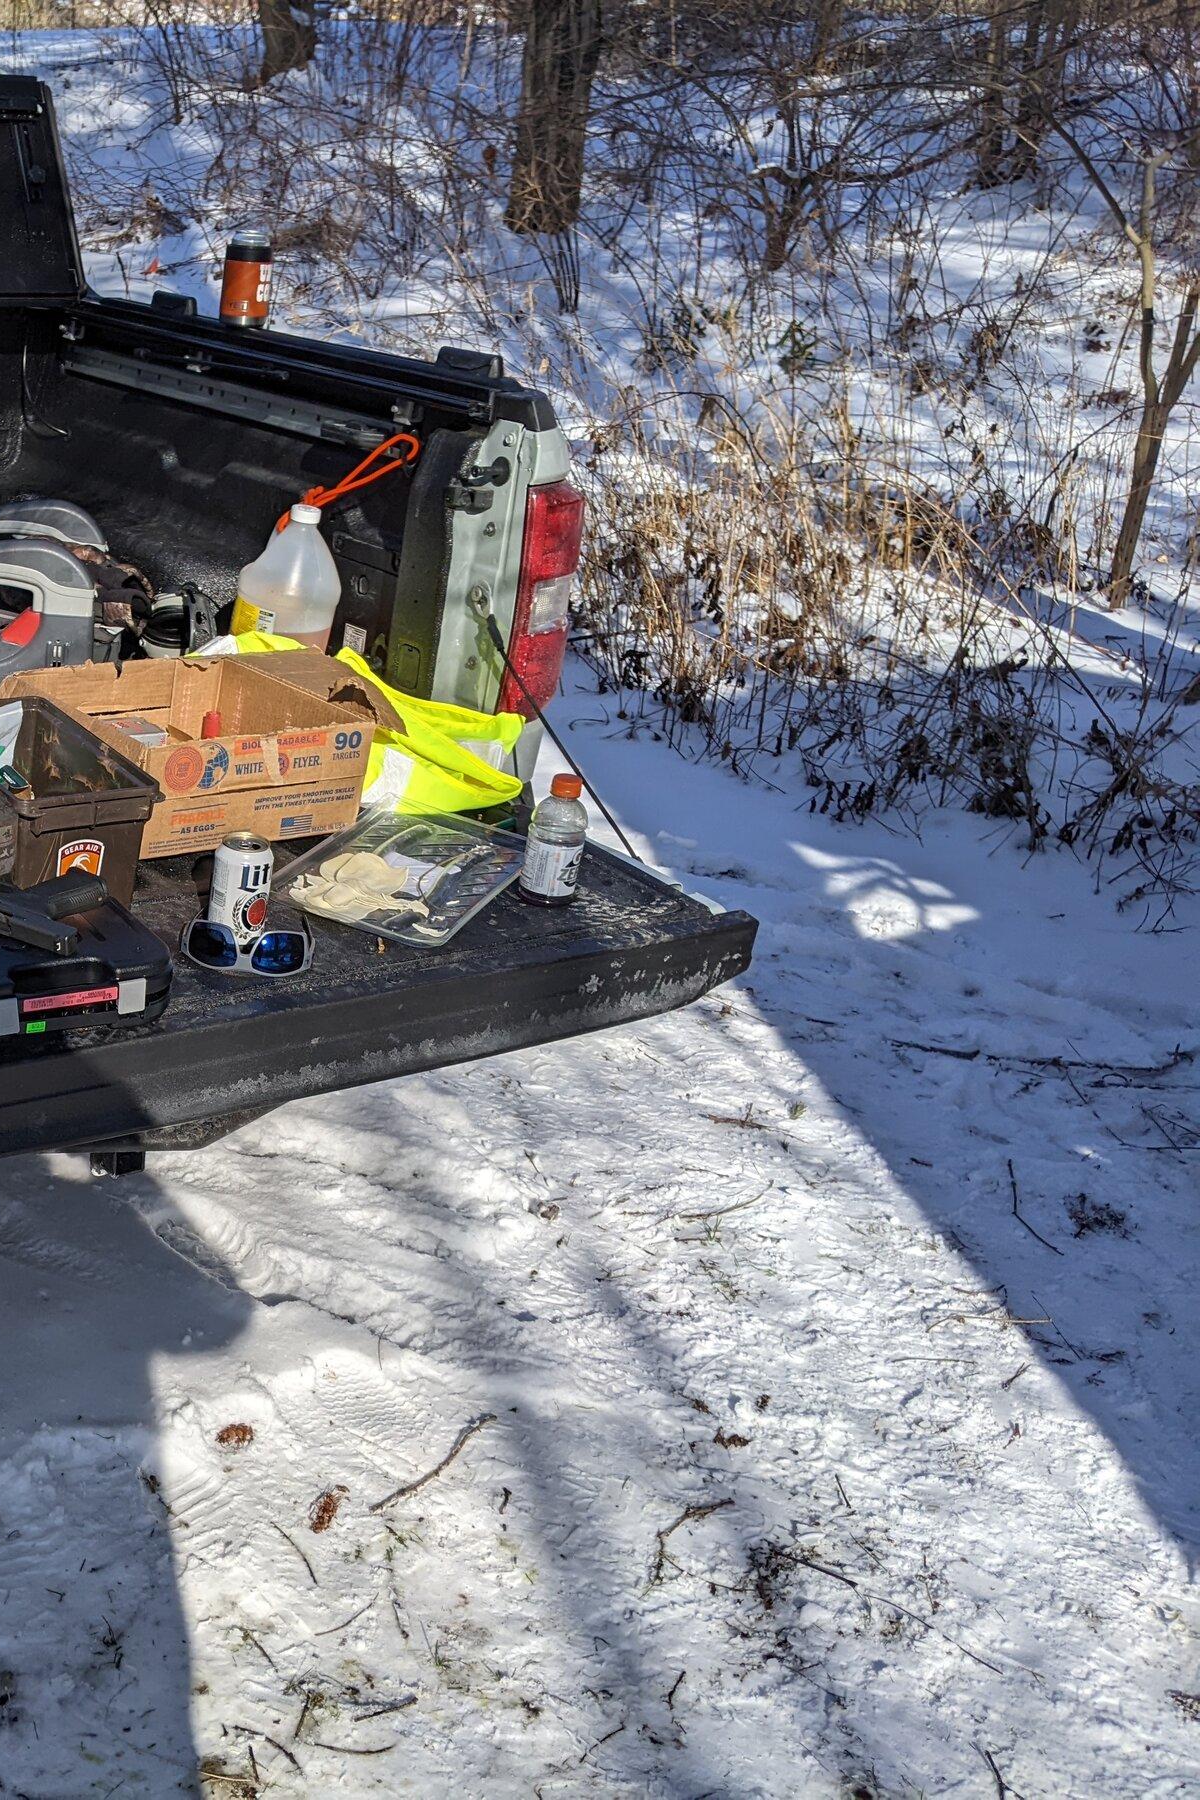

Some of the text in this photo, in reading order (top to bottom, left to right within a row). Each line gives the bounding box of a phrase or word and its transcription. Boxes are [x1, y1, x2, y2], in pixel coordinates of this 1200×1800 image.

[334, 731, 362, 750] 90
[332, 751, 360, 761] TARGETS
[235, 762, 263, 775] WHITE
[254, 786, 355, 804] IMPROVE YOUR SHOOTING SKILLS
[254, 803, 270, 811] WITH
[271, 801, 283, 809] THE
[284, 799, 306, 808] FINEST
[307, 796, 334, 805] TARGETS
[171, 810, 225, 826] FRAGILE
[180, 823, 215, 834] AS EGGS
[64, 843, 83, 855] GEAR
[237, 863, 271, 893] Lit
